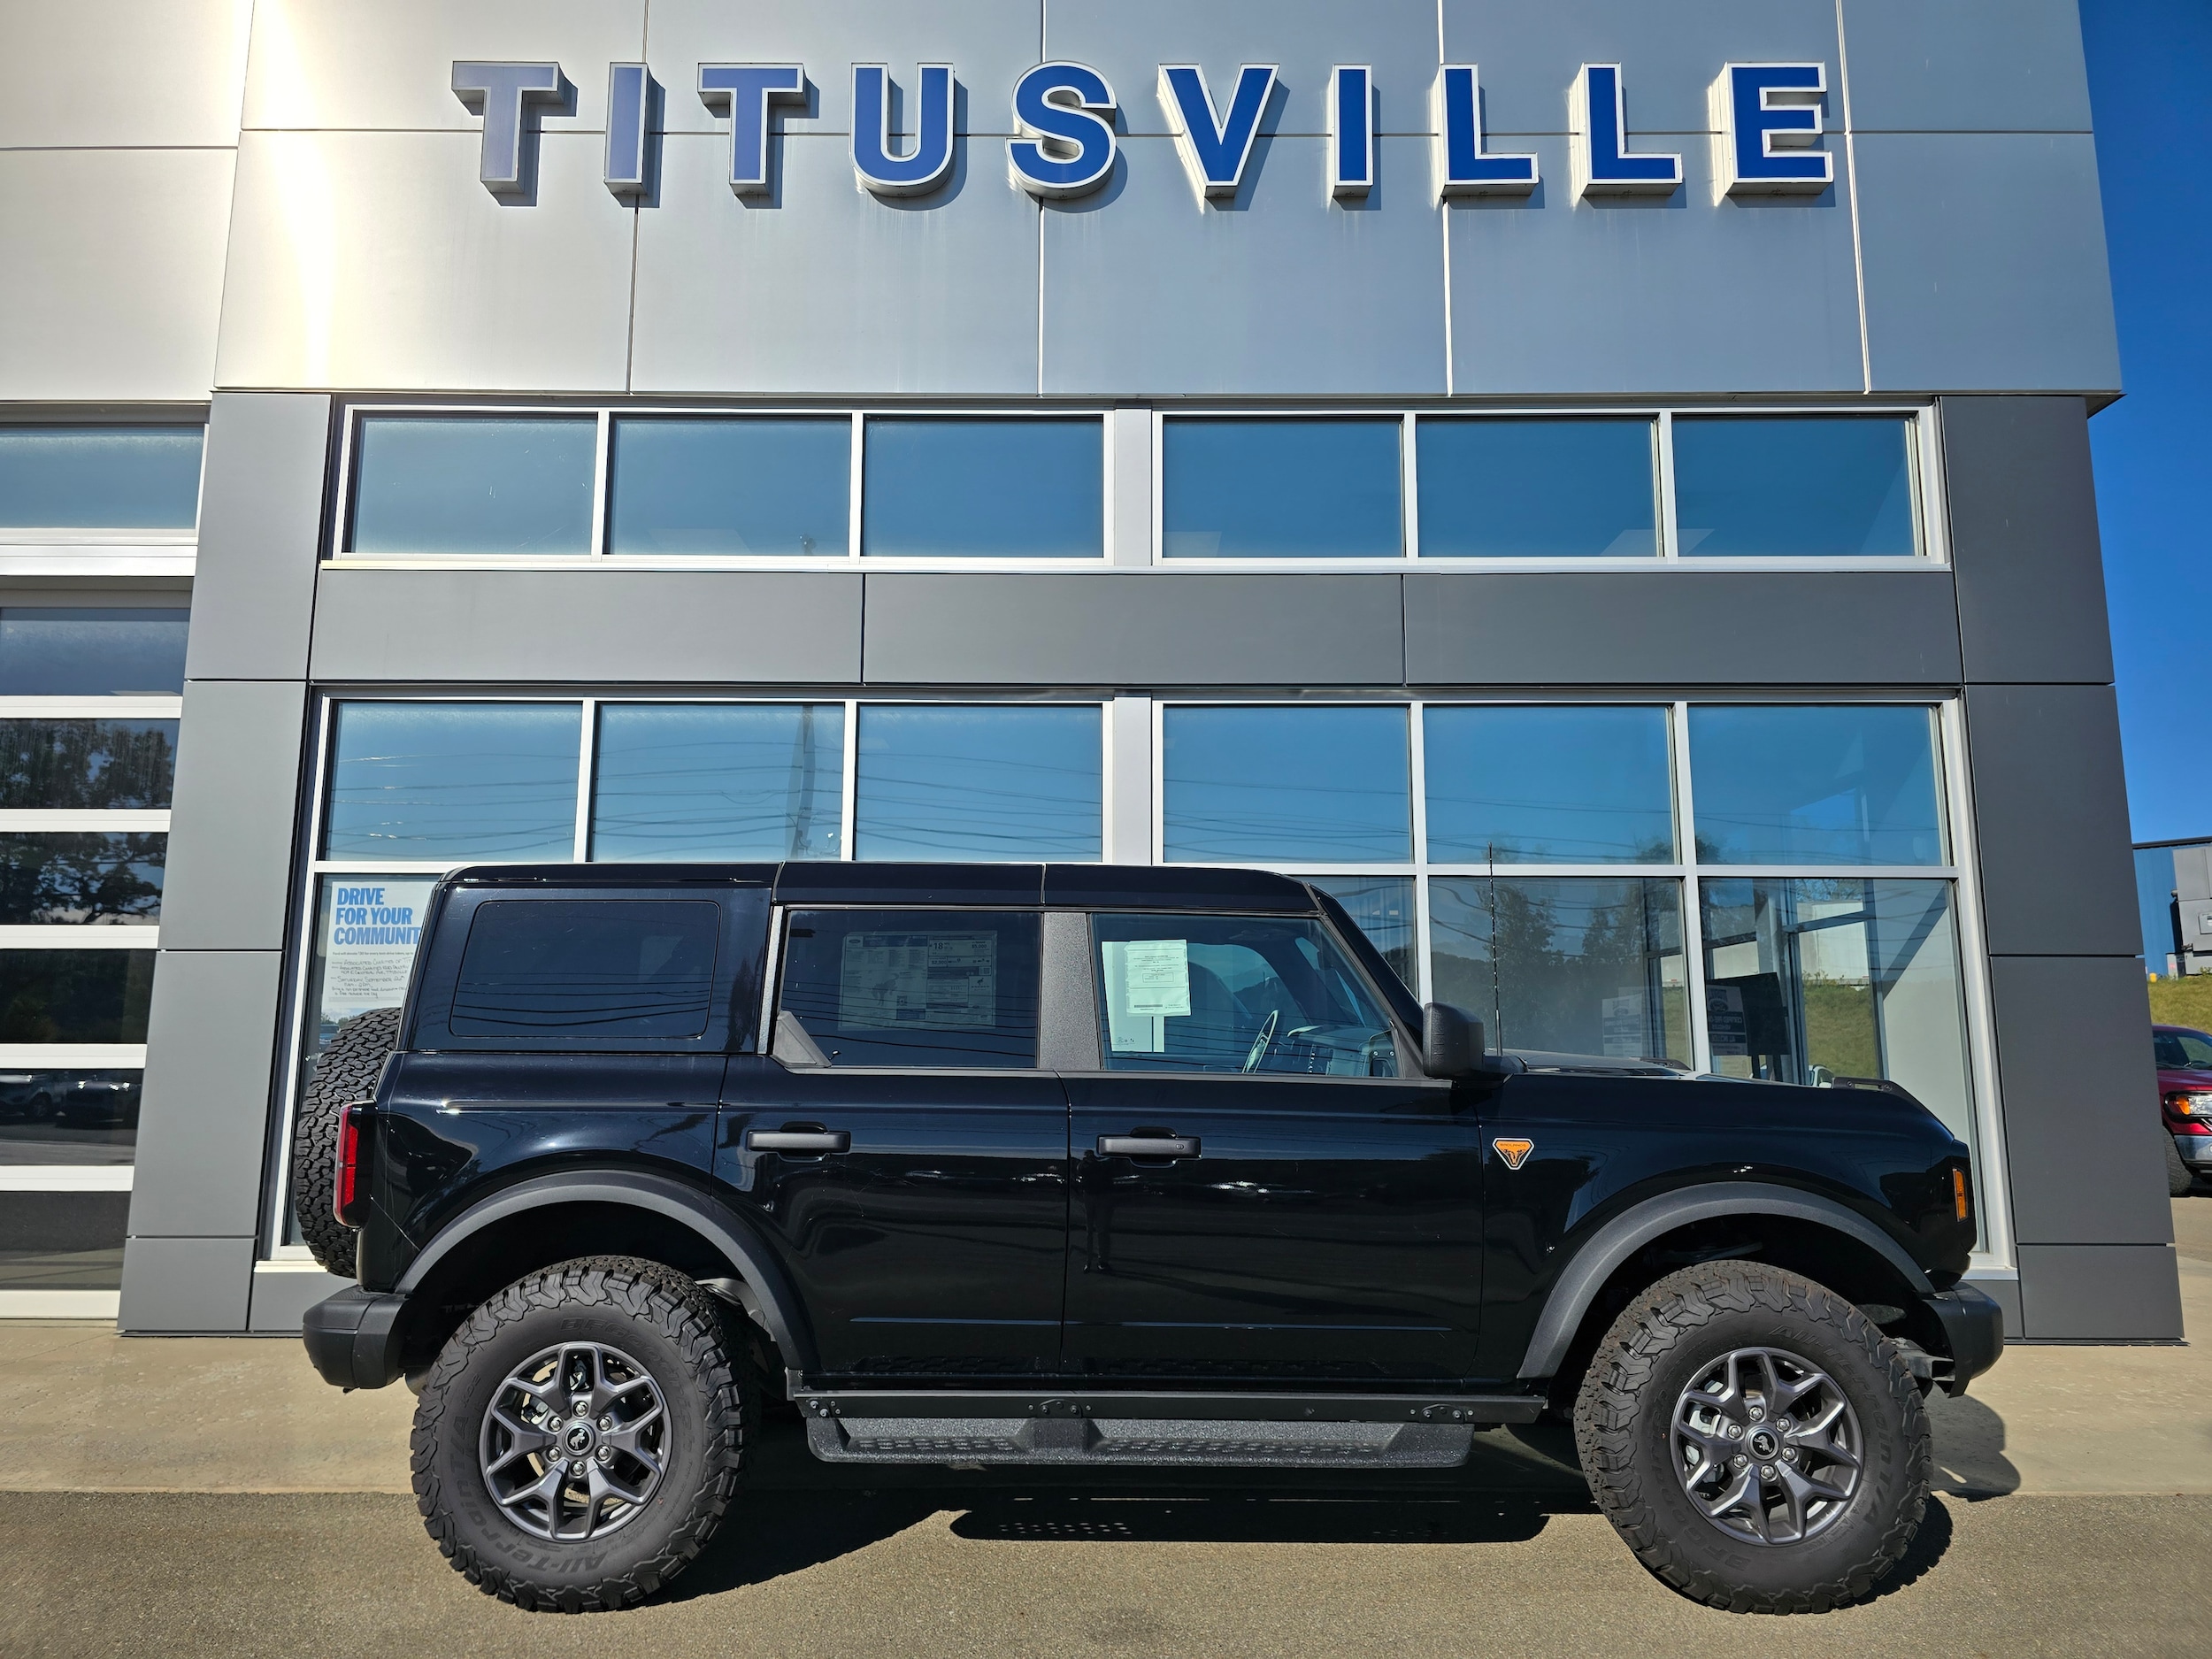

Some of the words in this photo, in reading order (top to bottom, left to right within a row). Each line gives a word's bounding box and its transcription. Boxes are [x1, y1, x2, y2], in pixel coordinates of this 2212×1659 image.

[451, 59, 1834, 194] TITUSVILLE
[337, 887, 385, 905] DRIVE
[335, 907, 367, 925] FOR
[371, 907, 412, 925] YOUR
